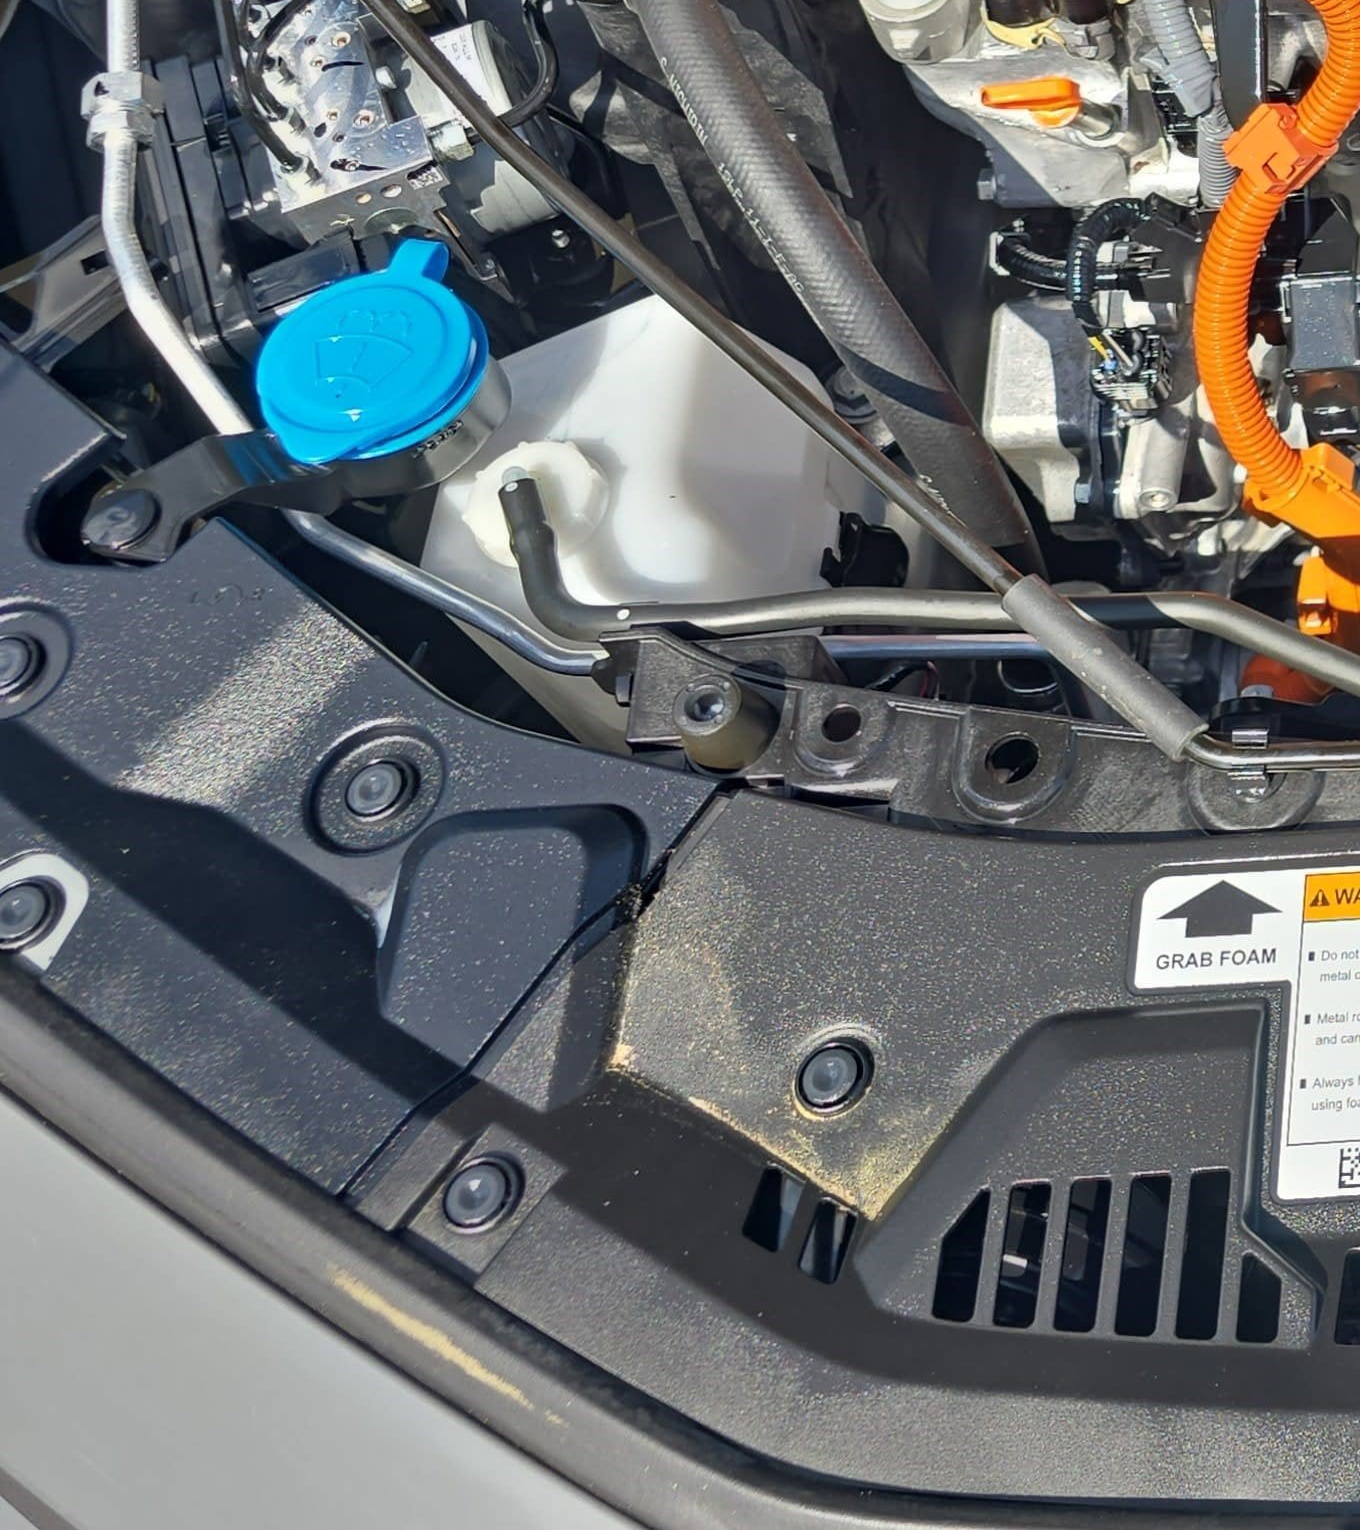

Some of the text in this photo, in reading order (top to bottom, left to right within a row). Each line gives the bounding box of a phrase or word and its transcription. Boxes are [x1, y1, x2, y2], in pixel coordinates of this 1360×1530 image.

[1156, 947, 1278, 970] GRAB FOAM
[1321, 950, 1338, 961] Do
[1340, 949, 1359, 960] not
[1320, 970, 1351, 982] metal
[1317, 1012, 1350, 1025] Metal
[1315, 1033, 1337, 1046] and
[1340, 1033, 1360, 1044] can
[1313, 1075, 1354, 1091] Always
[1311, 1097, 1343, 1112] using
